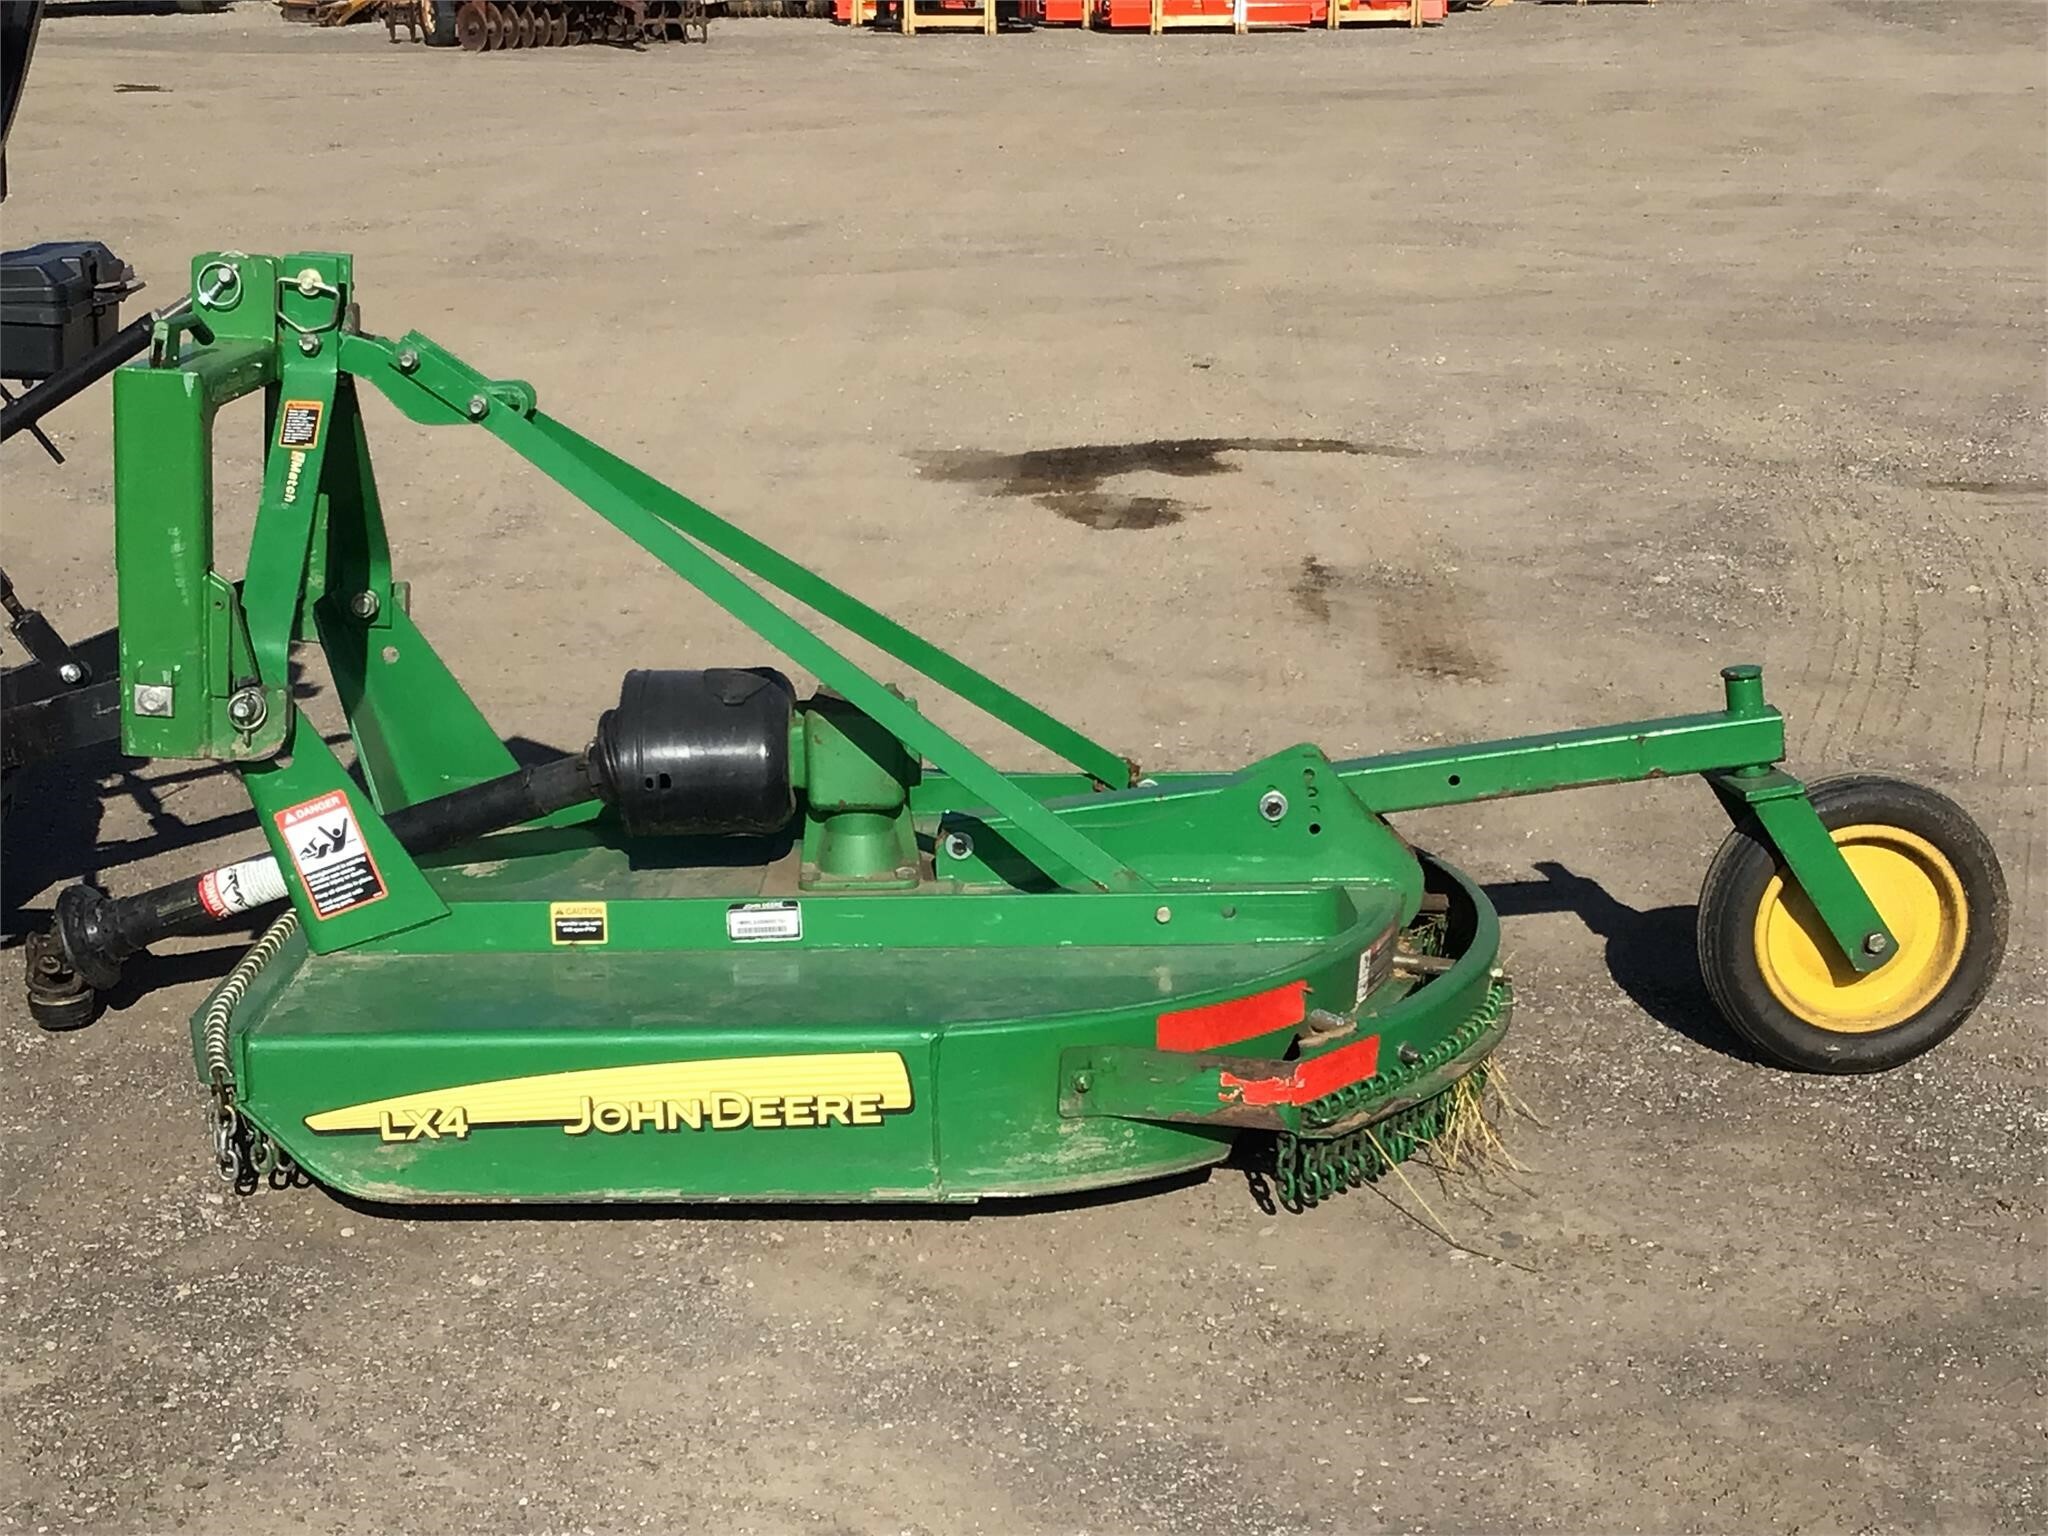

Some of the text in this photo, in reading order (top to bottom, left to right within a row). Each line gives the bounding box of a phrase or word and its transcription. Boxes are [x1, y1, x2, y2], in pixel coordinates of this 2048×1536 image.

[295, 796, 341, 819] DANGER
[566, 907, 602, 915] CAUTION
[379, 1106, 469, 1142] LX4
[563, 1090, 883, 1135] JOHN DEERE
